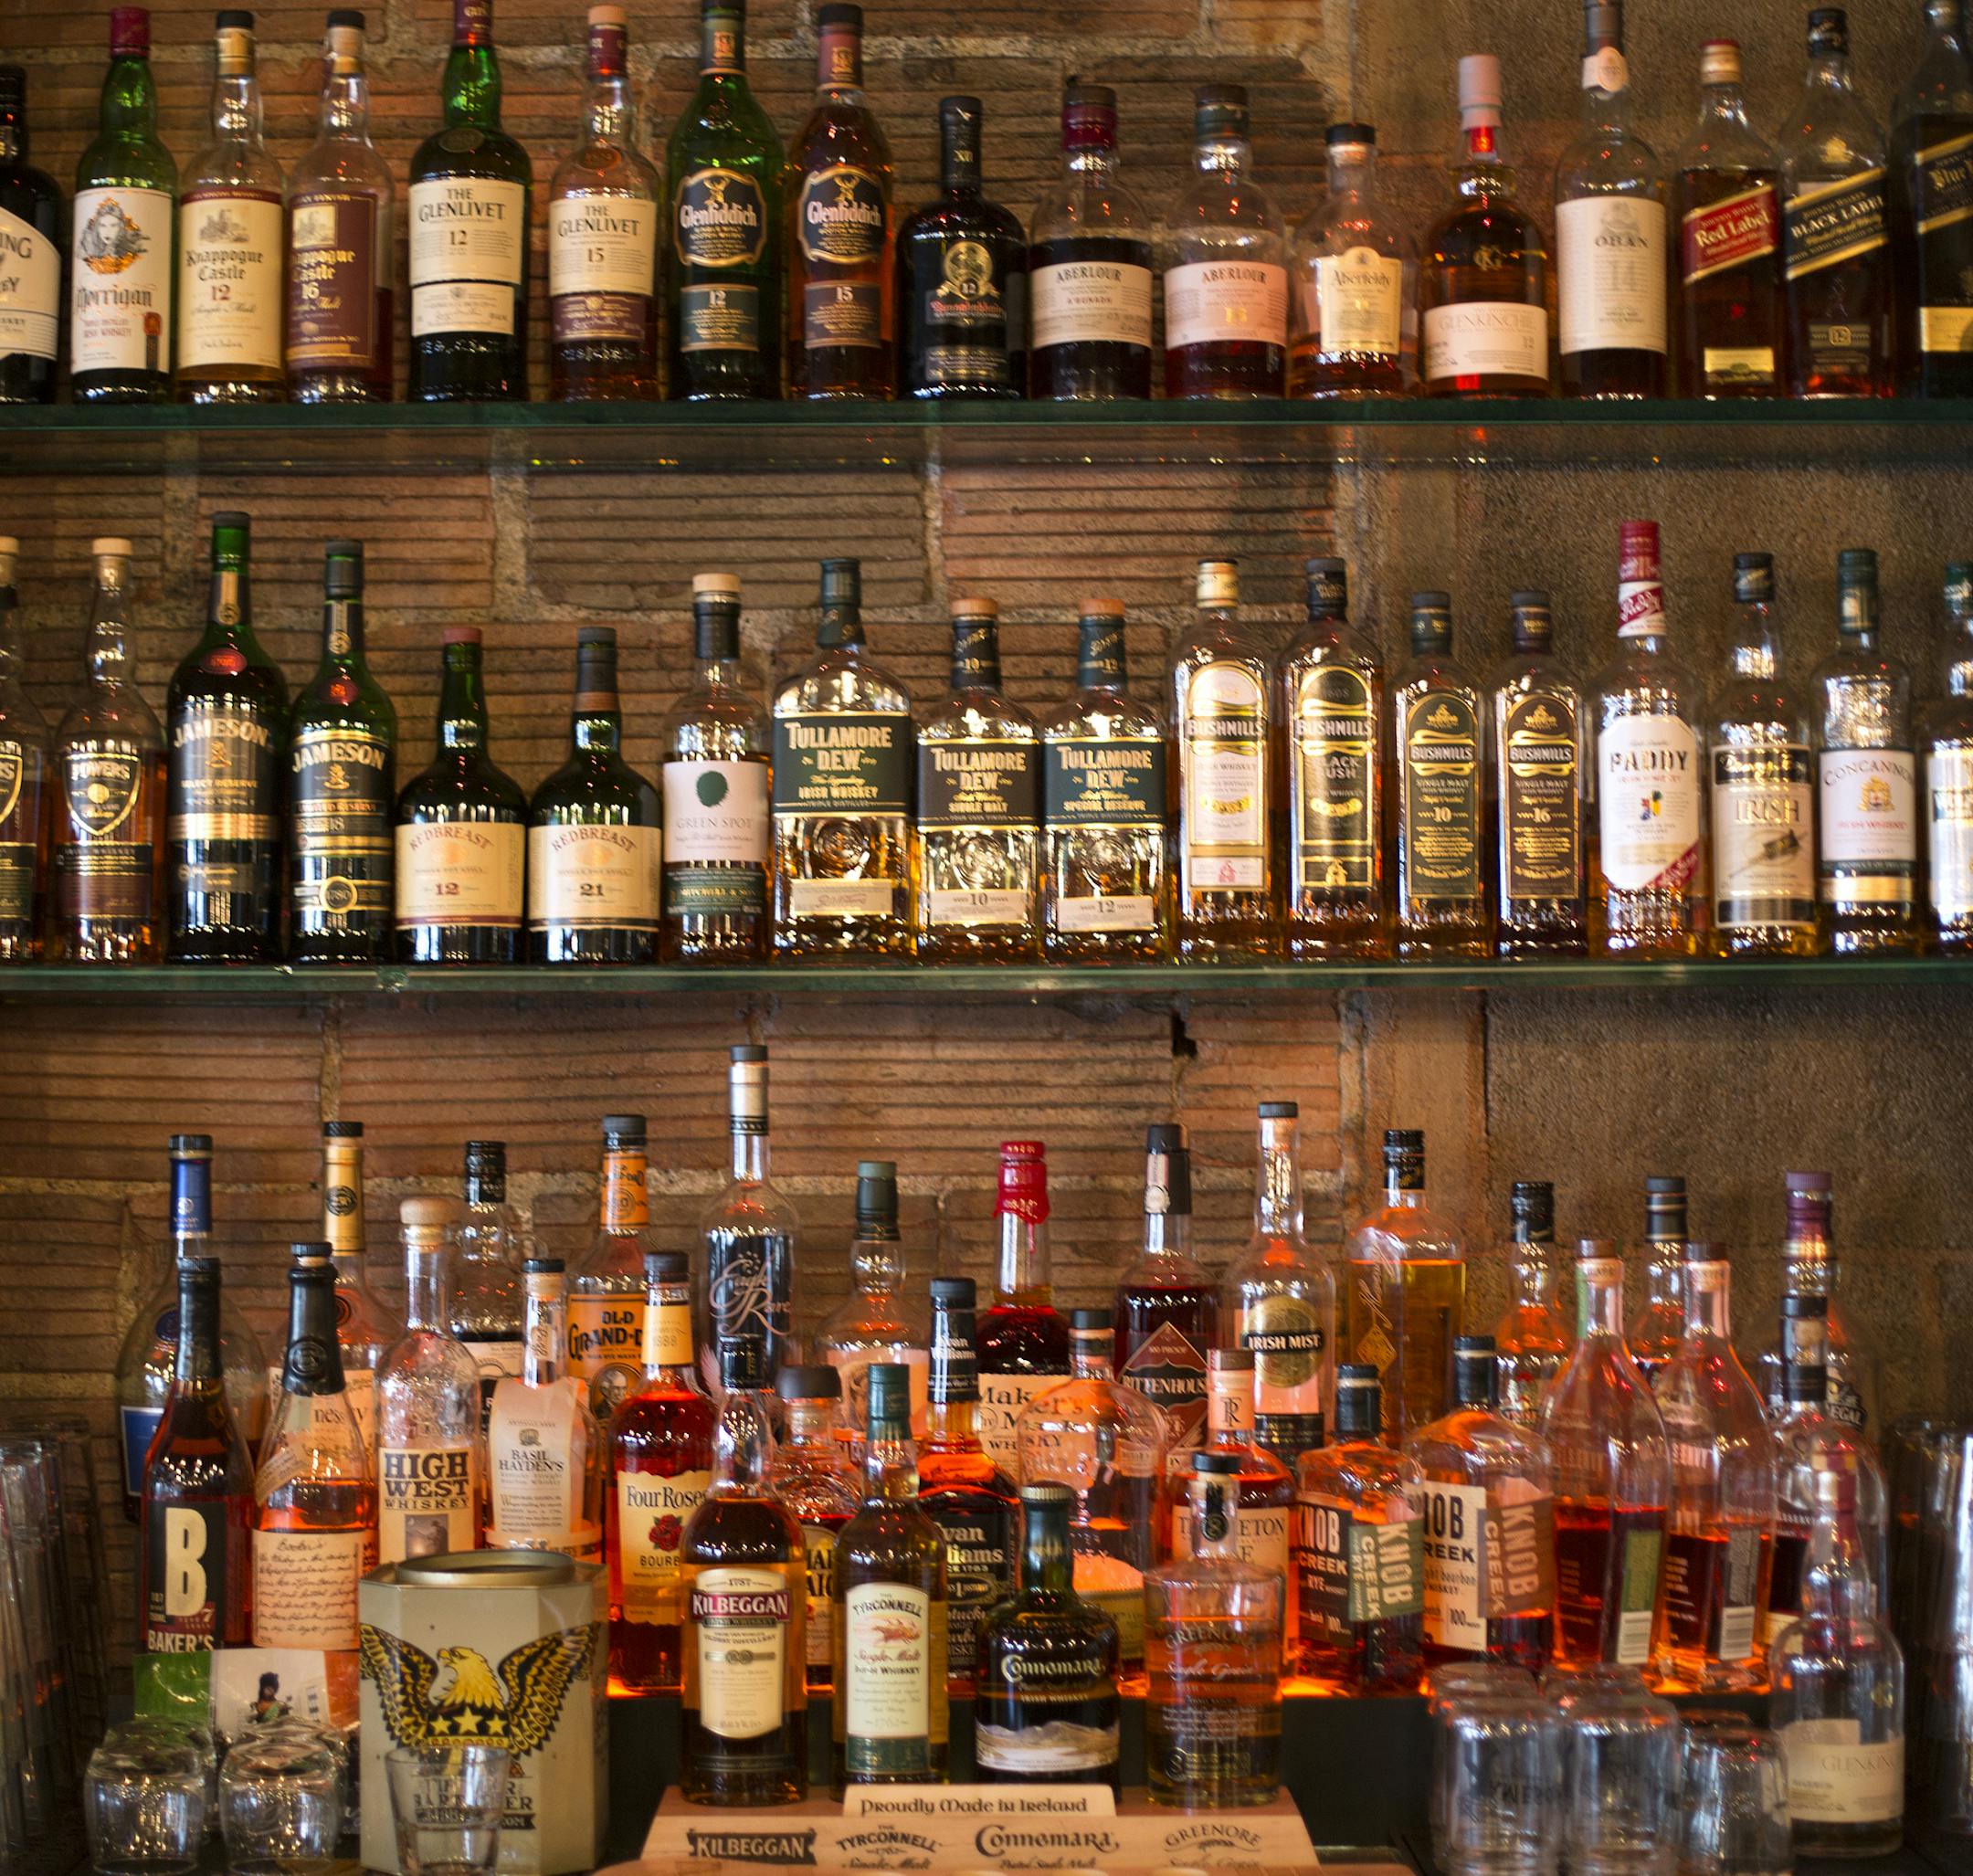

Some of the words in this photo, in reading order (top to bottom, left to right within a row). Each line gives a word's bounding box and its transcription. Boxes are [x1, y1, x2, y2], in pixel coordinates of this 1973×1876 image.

[446, 188, 474, 200] THE
[418, 201, 505, 222] GLENLIVET
[584, 205, 610, 216] THE
[681, 200, 757, 228] Glenfiddich
[807, 200, 881, 227] Glenfiddich
[1790, 212, 1839, 238] BLACK
[1841, 195, 1884, 220] LABEL
[558, 218, 641, 237] GLENLIVET
[1694, 224, 1729, 248] Red
[1728, 210, 1770, 236] Label
[448, 230, 469, 246] 12
[1595, 235, 1649, 248] OBAN
[185, 249, 264, 267] Knappogue
[586, 248, 605, 263] 15
[196, 265, 247, 281] Castle
[1056, 266, 1122, 284] ABERLOUR
[1202, 267, 1267, 285] ABERLOUR
[211, 284, 231, 301] 12
[301, 282, 320, 300] 16
[709, 290, 726, 306] 12
[836, 286, 853, 301] 15
[174, 717, 269, 748] JAMESON
[784, 722, 893, 750] TULLAMORE
[1187, 720, 1264, 737] BUSHMILLS
[1296, 720, 1373, 737] BUSHMILLS
[291, 742, 386, 774] JAMESON
[816, 749, 866, 771] DEW
[930, 747, 1027, 772] TULLAMORE
[1056, 745, 1153, 770] TULLAMORE
[1410, 744, 1473, 762] BUSHMILLS
[1509, 744, 1573, 762] BUSHMILLS
[1609, 749, 1688, 773] PADDY
[70, 761, 131, 781] POWERS
[959, 770, 1002, 791] DEW
[1085, 769, 1129, 789] DEW
[798, 785, 828, 799] IRISH
[829, 785, 880, 799] WHISKEY
[1433, 806, 1451, 822] 10
[1534, 806, 1552, 822] 16
[1736, 797, 1800, 824] IRISH
[676, 817, 719, 829] GREEN
[722, 816, 754, 829] SPOT
[409, 825, 494, 851] REDBREAST
[551, 827, 638, 853] REDBREAST
[435, 882, 460, 896] 12
[580, 882, 605, 896] 21
[969, 891, 988, 906] 10
[1097, 900, 1115, 913] 12
[601, 1311, 635, 1324] OLD
[1248, 1335, 1287, 1350] IRISH
[1288, 1333, 1321, 1348] MIST
[1121, 1376, 1208, 1395] RITTENHOUS
[511, 1449, 548, 1460] BASIL
[385, 1452, 469, 1481] HIGH
[499, 1460, 564, 1472] HAYDEN'S
[385, 1479, 469, 1498] WEST
[627, 1485, 660, 1507] Four
[385, 1498, 469, 1510] WHISKEY
[942, 1525, 986, 1543] van
[1178, 1516, 1286, 1536] TETON
[639, 1555, 680, 1566] BOURB
[1423, 1542, 1476, 1564] REEK
[1501, 1505, 1540, 1597] KNOB
[165, 1506, 207, 1617] B
[1298, 1551, 1348, 1576] CREEK
[1377, 1522, 1414, 1605] KNOB
[1483, 1519, 1507, 1614] CREEK
[1307, 1575, 1325, 1592] RYE
[1361, 1535, 1381, 1618] CREEK
[1441, 1566, 1477, 1586] bourbon
[692, 1594, 789, 1616] KILBEGGAN
[852, 1598, 923, 1618] TYRCONNELL
[202, 1608, 214, 1623] 7
[1450, 1608, 1466, 1626] 100
[148, 1628, 215, 1654] BAKER'S
[1821, 1755, 1895, 1772] GLENKIN
[861, 1797, 935, 1817] Proudly
[941, 1797, 994, 1813] Made
[998, 1797, 1015, 1812] in
[1019, 1797, 1088, 1813] Ireland
[835, 1831, 940, 1853] TYRCONNELL
[974, 1824, 1120, 1859] Connemara
[1163, 1824, 1262, 1848] GREENORE
[696, 1835, 806, 1859] KILBEGGAN
